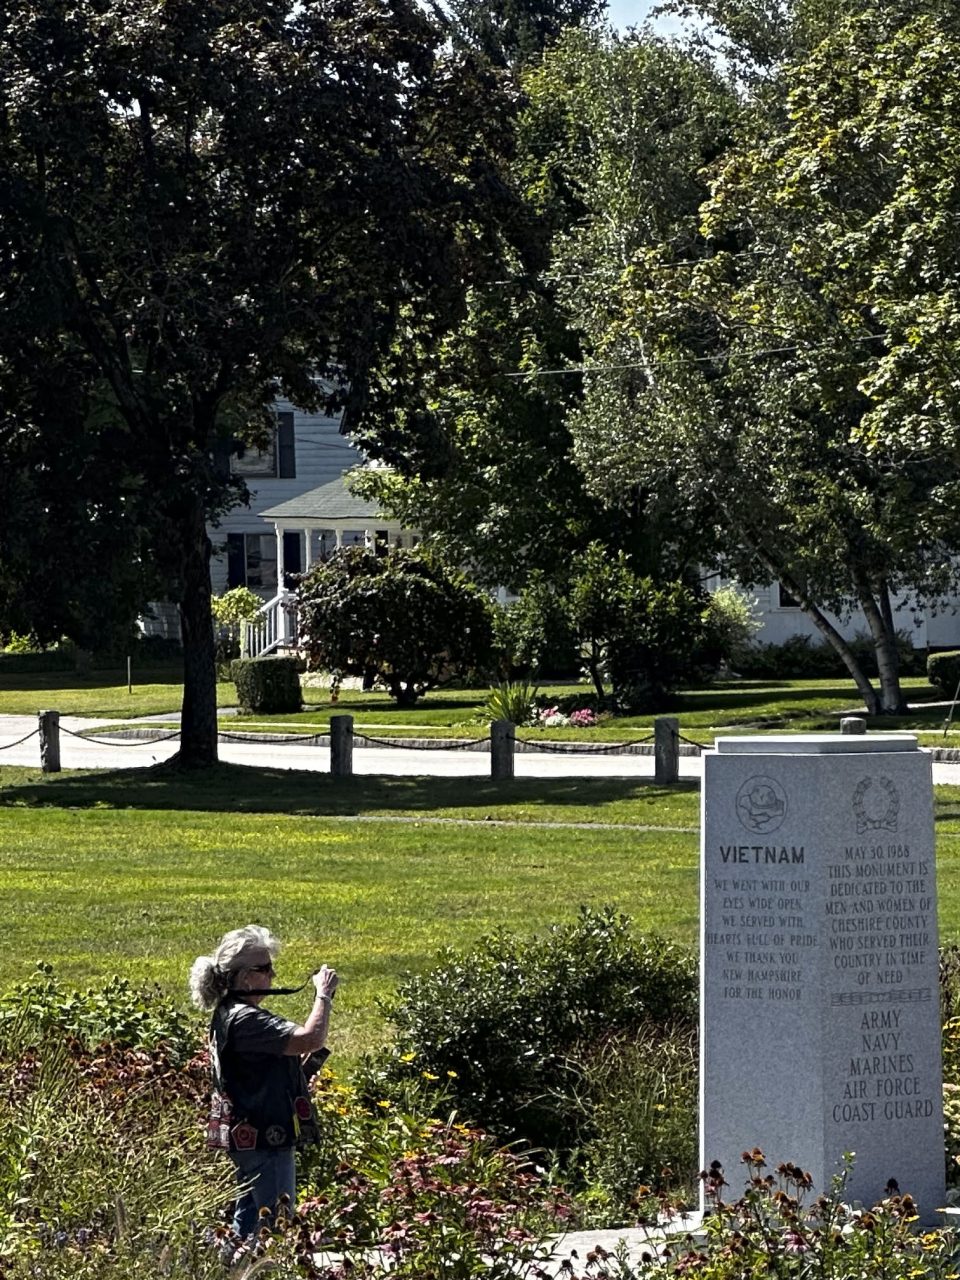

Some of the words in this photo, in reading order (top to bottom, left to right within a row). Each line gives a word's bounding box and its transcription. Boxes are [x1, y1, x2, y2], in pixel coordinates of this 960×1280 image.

[719, 845, 805, 864] VIETNAM
[844, 846, 866, 860] MAY
[887, 845, 910, 858] 1988
[828, 864, 852, 879] THIS
[856, 862, 916, 877] MONUMENT
[919, 860, 929, 875] IS
[714, 879, 728, 891] WE
[733, 880, 757, 891] WENT
[761, 880, 785, 892] WITH
[790, 880, 810, 892] OUR
[830, 881, 887, 897] DEDICATED
[891, 880, 904, 894] TO
[907, 879, 926, 893] THE
[723, 897, 744, 909] EYES
[749, 898, 773, 909] WIDE
[825, 901, 847, 915] MEN
[851, 900, 874, 914] AND
[877, 898, 916, 913] WOMEN
[920, 897, 932, 911] OF
[722, 915, 737, 927] WE
[740, 915, 775, 928] SERVED
[779, 916, 803, 928] WITH
[831, 917, 883, 933] CHESHIRE
[885, 915, 928, 930] COUNTY
[707, 933, 741, 945] HEARTS
[747, 934, 770, 946] FULL
[773, 934, 785, 946] OF
[790, 935, 818, 947] PRIDE
[829, 936, 854, 950] WHO
[857, 934, 897, 949] SERVED
[899, 932, 930, 948] THEIR
[726, 951, 740, 962] WE
[744, 952, 776, 964] THANK
[780, 952, 798, 964] YOU
[834, 953, 881, 969] COUNTRY
[886, 951, 897, 966] IN
[901, 950, 926, 965] TIME
[723, 969, 742, 981] NEW
[747, 969, 802, 983] HAMPSHIRE
[857, 971, 871, 985] OF
[877, 970, 903, 985] NEED
[724, 987, 741, 999] FOR
[747, 987, 762, 999] THE
[769, 988, 802, 1000] HONOR
[861, 1009, 901, 1030] ARMY
[861, 1032, 902, 1053] NAVY
[849, 1054, 914, 1077] MARINES
[842, 1080, 868, 1100] AIR
[876, 1076, 921, 1098] FORCE
[832, 1102, 877, 1123] COAST
[883, 1099, 934, 1121] GUARD
